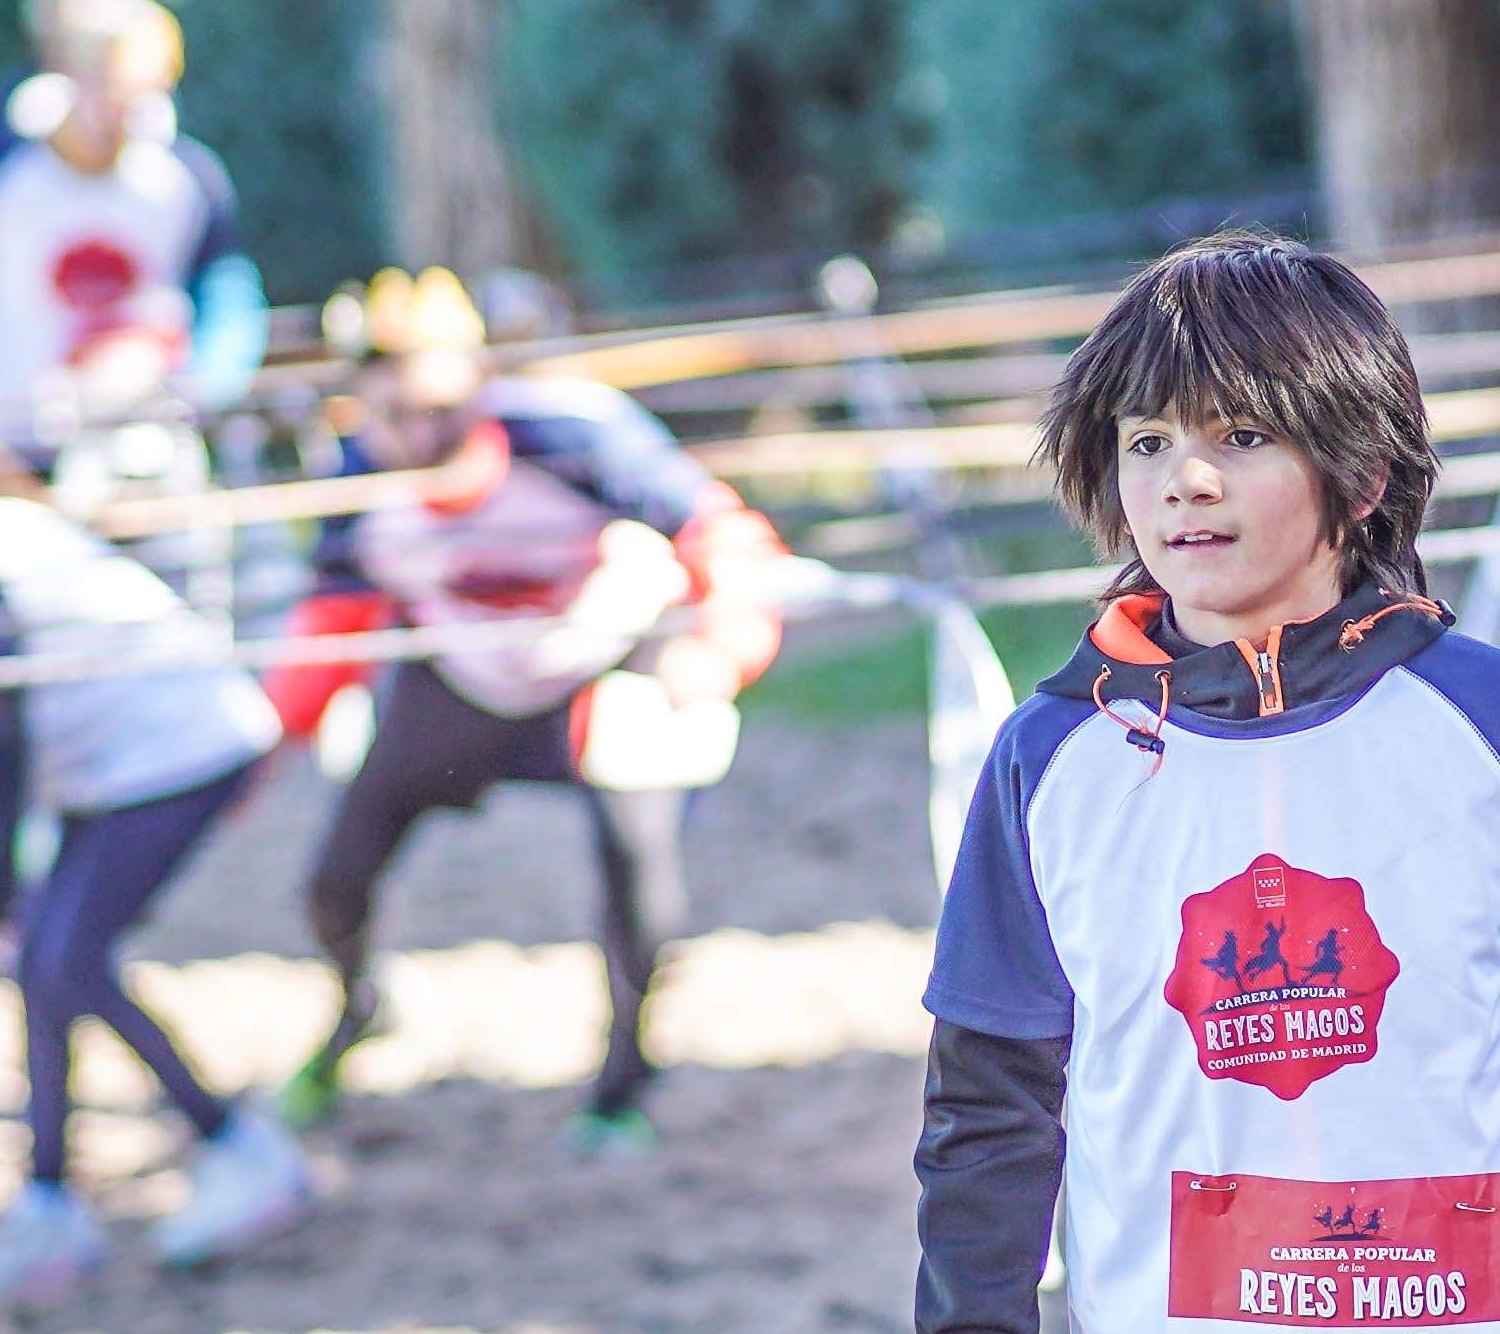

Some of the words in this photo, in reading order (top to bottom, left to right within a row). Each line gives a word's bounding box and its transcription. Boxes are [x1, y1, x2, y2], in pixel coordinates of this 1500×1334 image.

[1215, 990, 1279, 1011] CARRERA
[1282, 987, 1346, 999] POPULAR
[1204, 1013, 1275, 1051] REYES
[1284, 1005, 1365, 1042] MAGOS
[1207, 1050, 1287, 1071] COMUNIDAD
[1291, 1049, 1309, 1060] DE
[1312, 1043, 1367, 1058] MADRID
[1270, 1247, 1350, 1261] CARRERA
[1353, 1247, 1436, 1262] POPULAR
[1337, 1263, 1349, 1272] de
[1351, 1263, 1365, 1273] los
[1239, 1268, 1338, 1318] REYES
[1352, 1271, 1467, 1320] MAGOS
